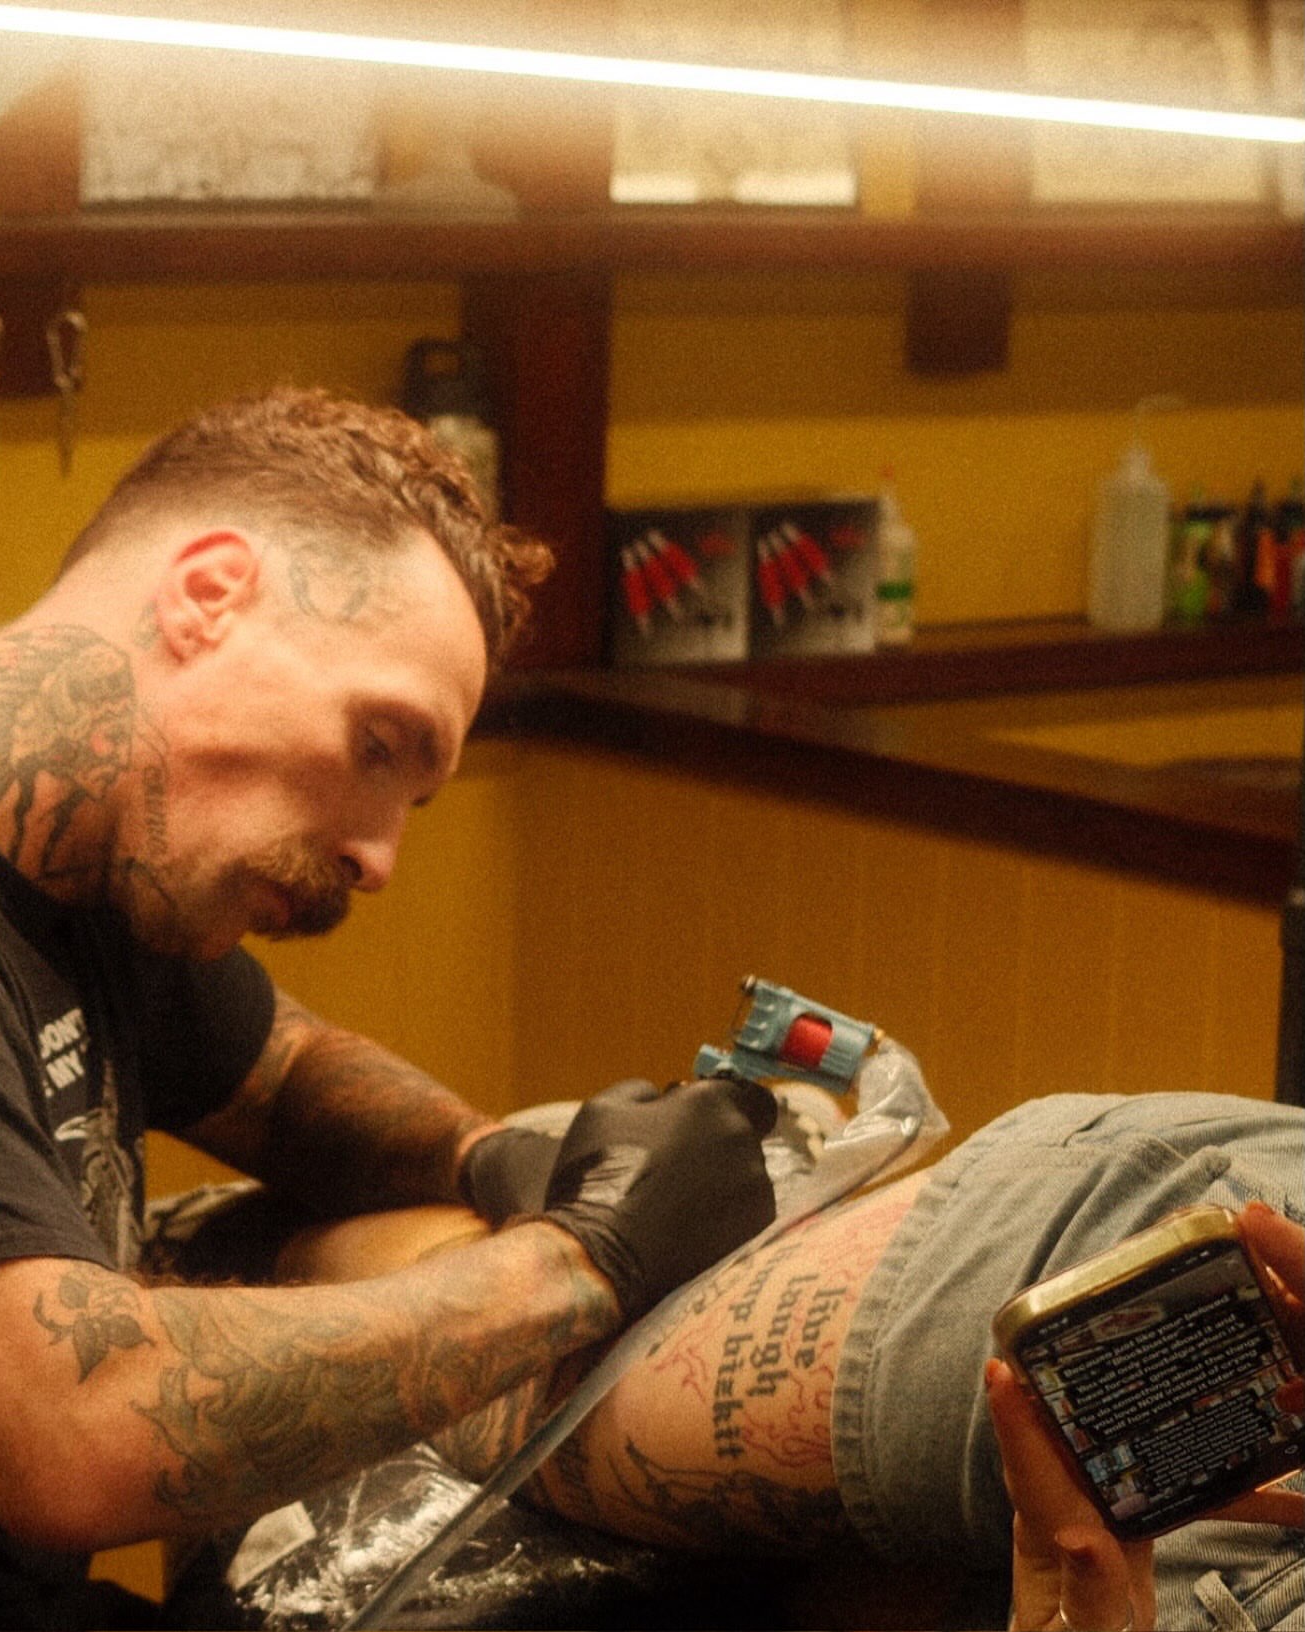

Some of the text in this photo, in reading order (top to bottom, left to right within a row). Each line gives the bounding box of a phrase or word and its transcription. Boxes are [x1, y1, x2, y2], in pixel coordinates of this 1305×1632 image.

[46, 1050, 84, 1088] MY
[746, 1274, 819, 1397] laugh
[794, 1287, 846, 1369] live
[712, 1333, 753, 1458] bizkit
